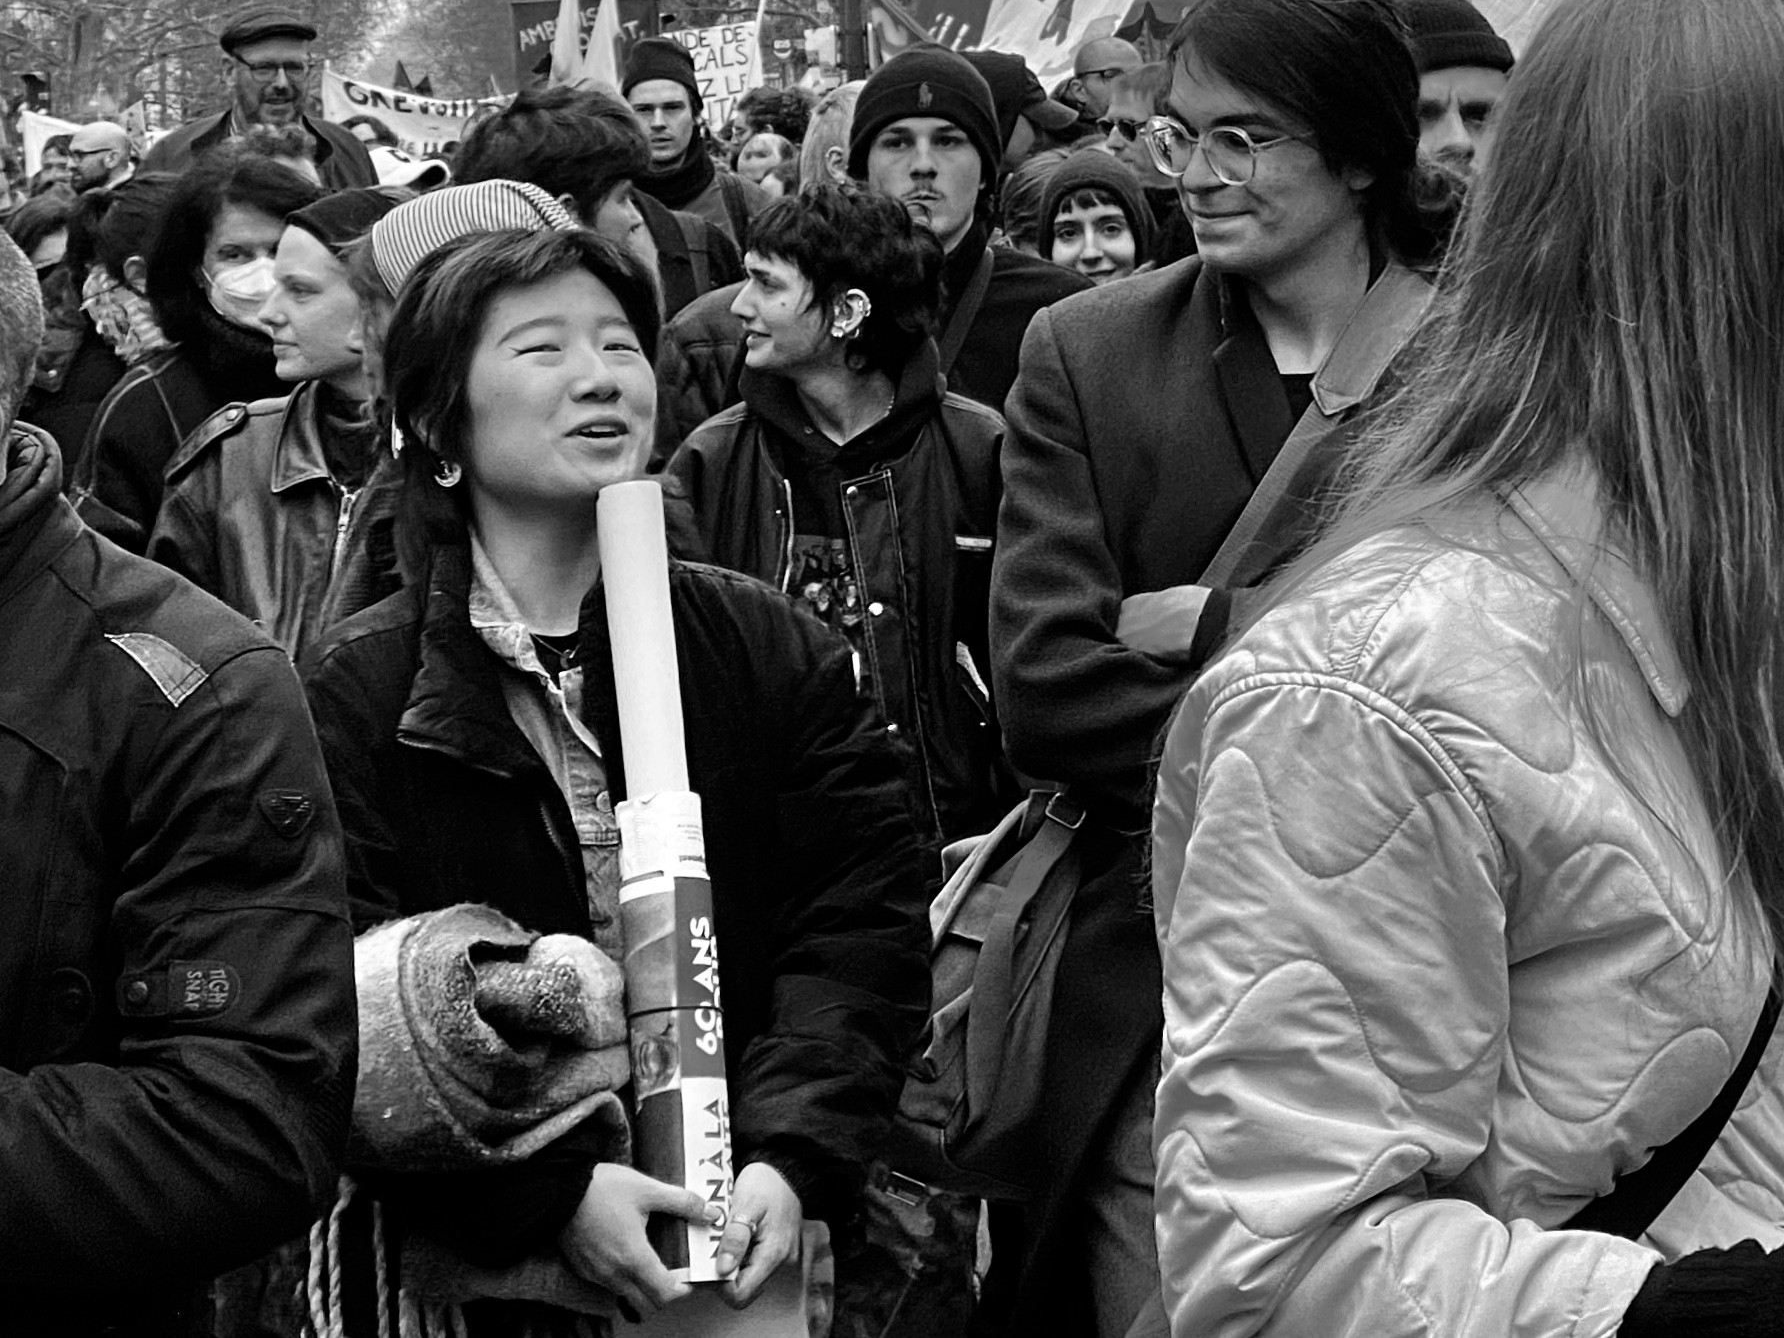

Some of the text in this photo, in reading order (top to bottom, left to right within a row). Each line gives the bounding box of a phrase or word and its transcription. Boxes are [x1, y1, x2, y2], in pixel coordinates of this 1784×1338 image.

[689, 916, 718, 1056] 60 ANS
[703, 1098, 722, 1139] LA
